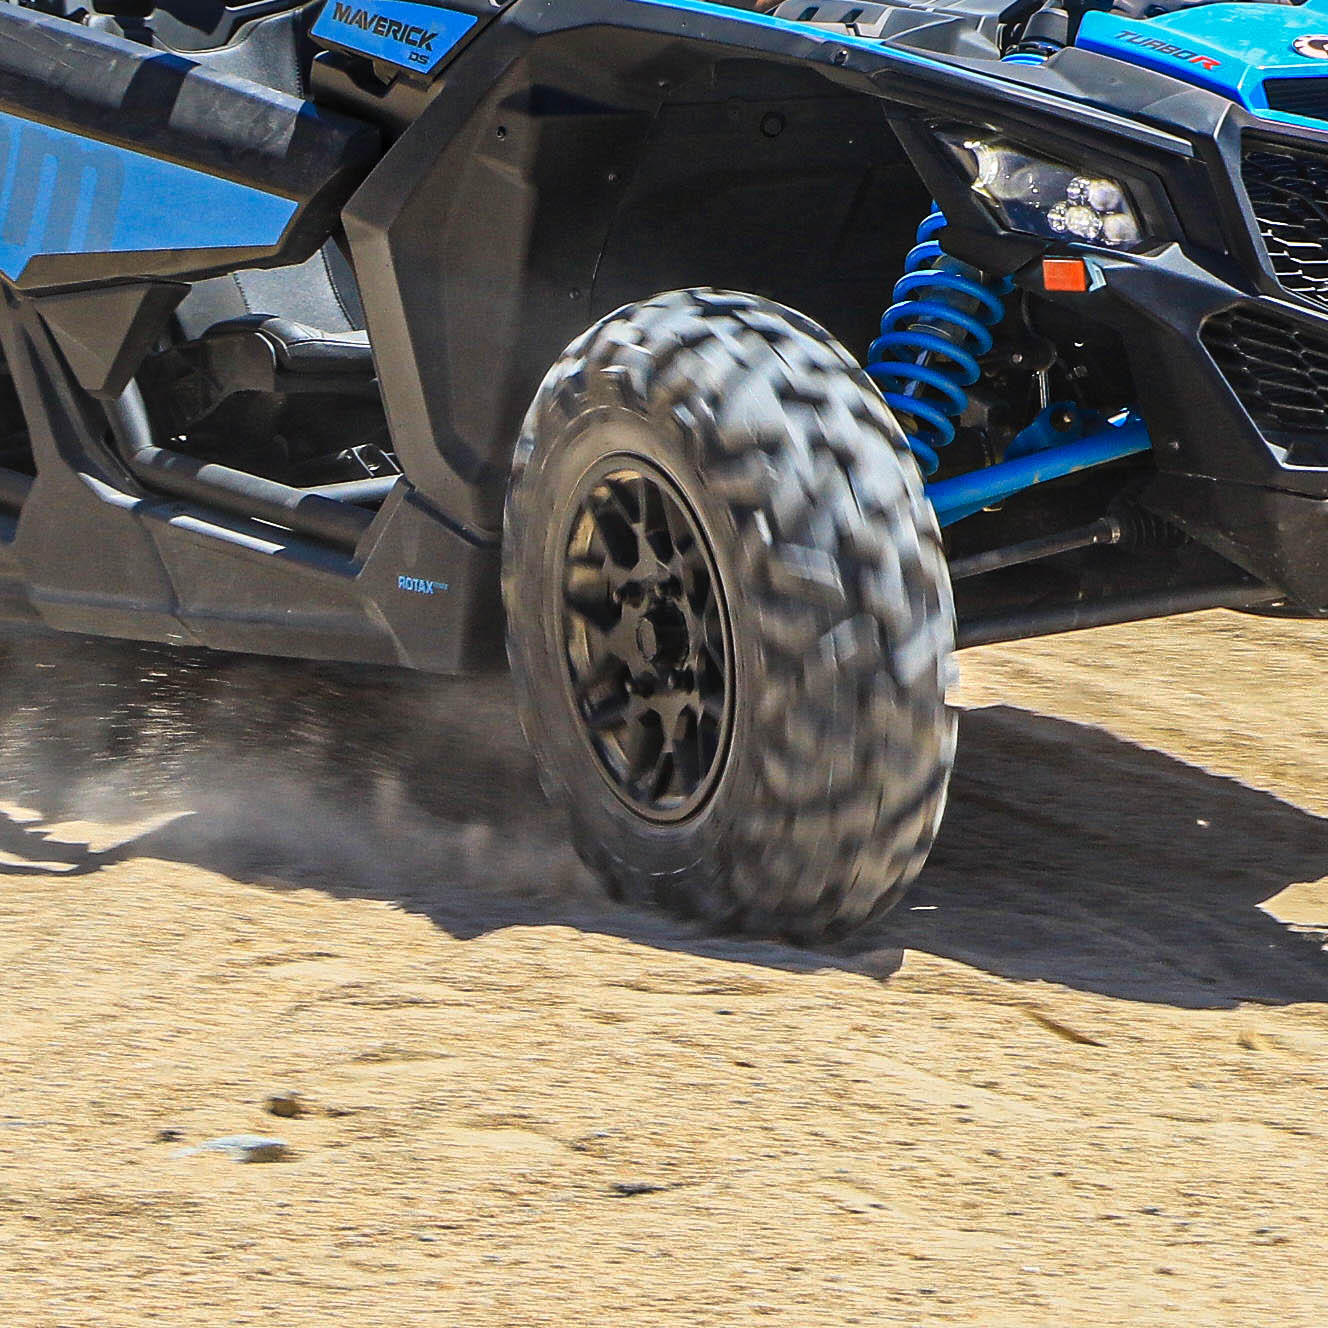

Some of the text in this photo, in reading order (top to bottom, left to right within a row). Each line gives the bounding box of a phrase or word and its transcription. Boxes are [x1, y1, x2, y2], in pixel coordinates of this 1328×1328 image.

[332, 2, 439, 52] MAVERICK
[408, 51, 430, 65] DS
[397, 575, 435, 594] ROTAX
